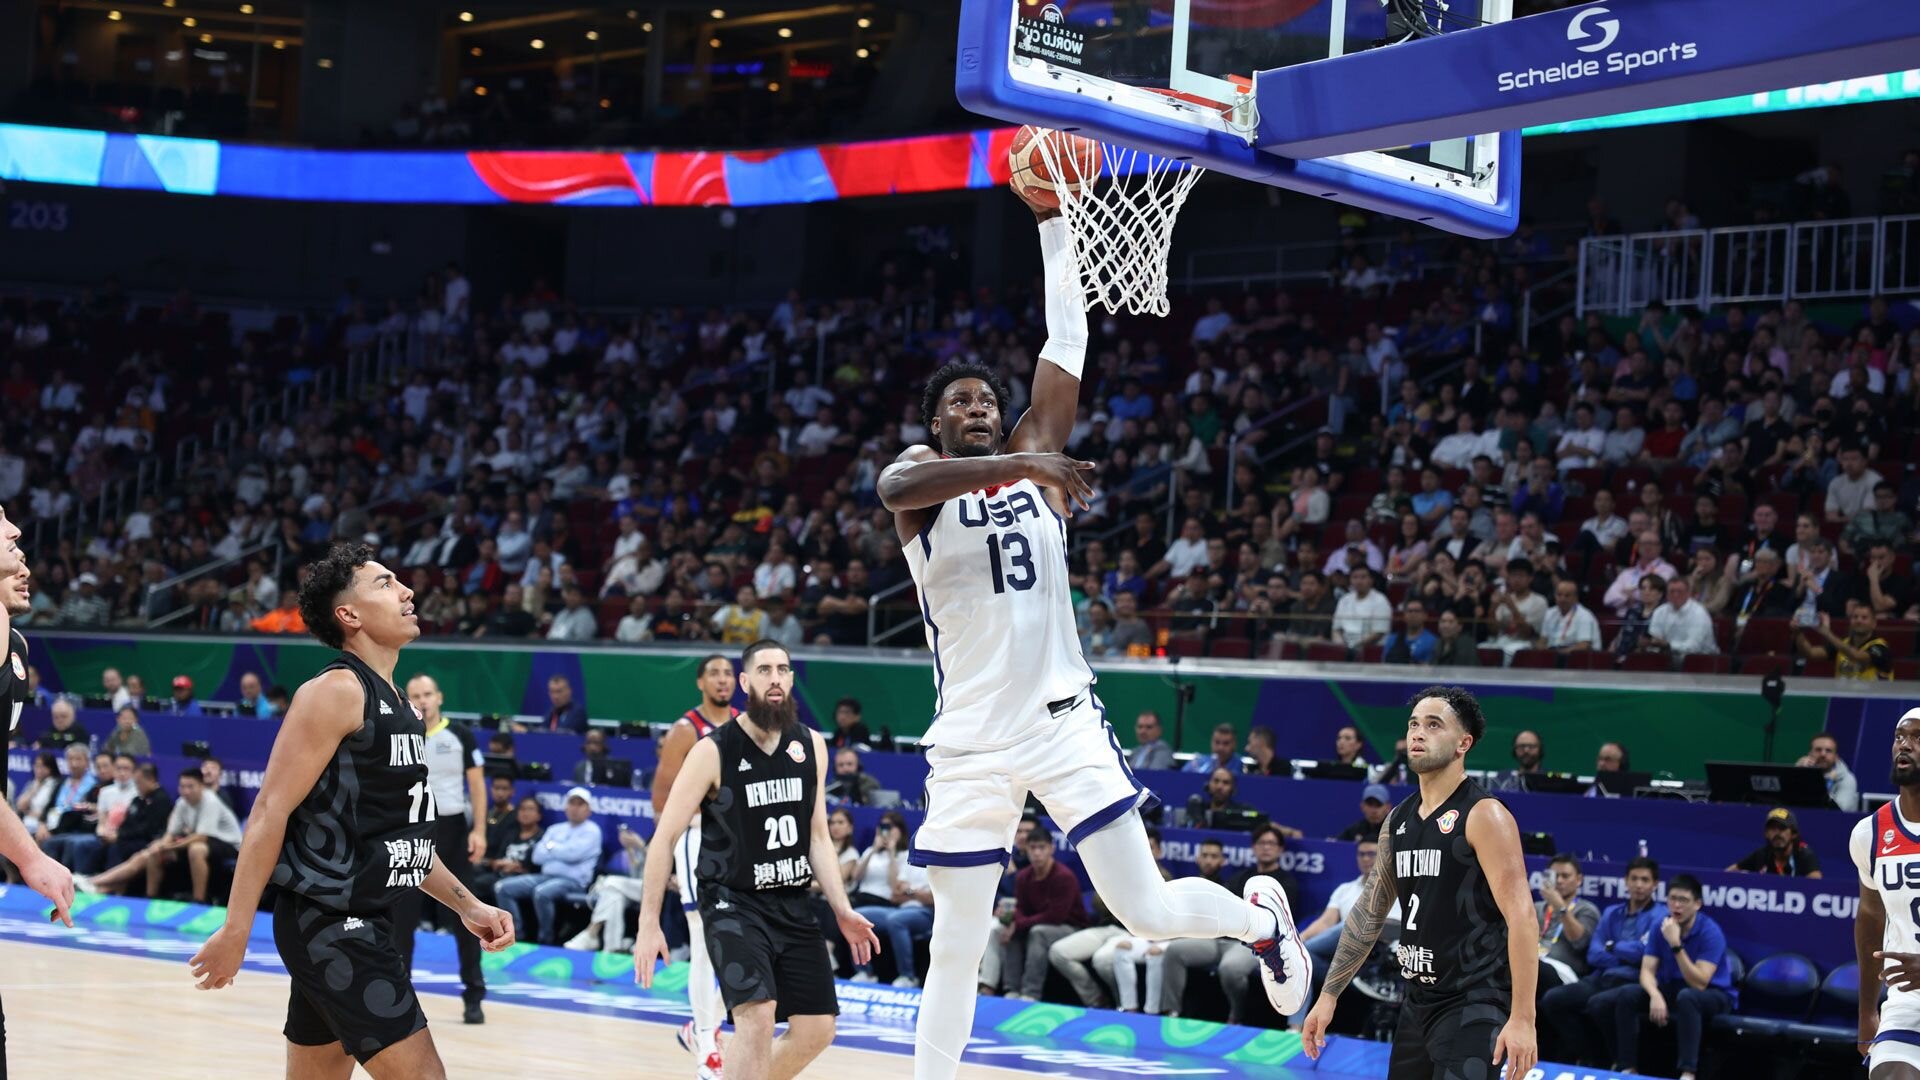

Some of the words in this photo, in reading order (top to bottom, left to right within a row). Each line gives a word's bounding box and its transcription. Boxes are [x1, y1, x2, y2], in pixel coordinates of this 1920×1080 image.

[1498, 59, 1600, 92] Schelde
[1606, 42, 1698, 75] Sports
[10, 201, 69, 231] 203
[959, 491, 1041, 528] USA
[986, 532, 1037, 594] 13
[389, 734, 414, 767] NEW
[408, 781, 436, 823] 11
[745, 781, 769, 808] NEW
[766, 777, 803, 804] ZEALAND
[764, 815, 799, 850] 20
[384, 839, 436, 869] 澳洲
[1280, 851, 1325, 874] 023
[1396, 850, 1412, 878] NEW
[1882, 861, 1920, 890] US
[1406, 893, 1420, 931] 2
[1702, 885, 1806, 915] WORLD
[343, 918, 365, 931] PEAK
